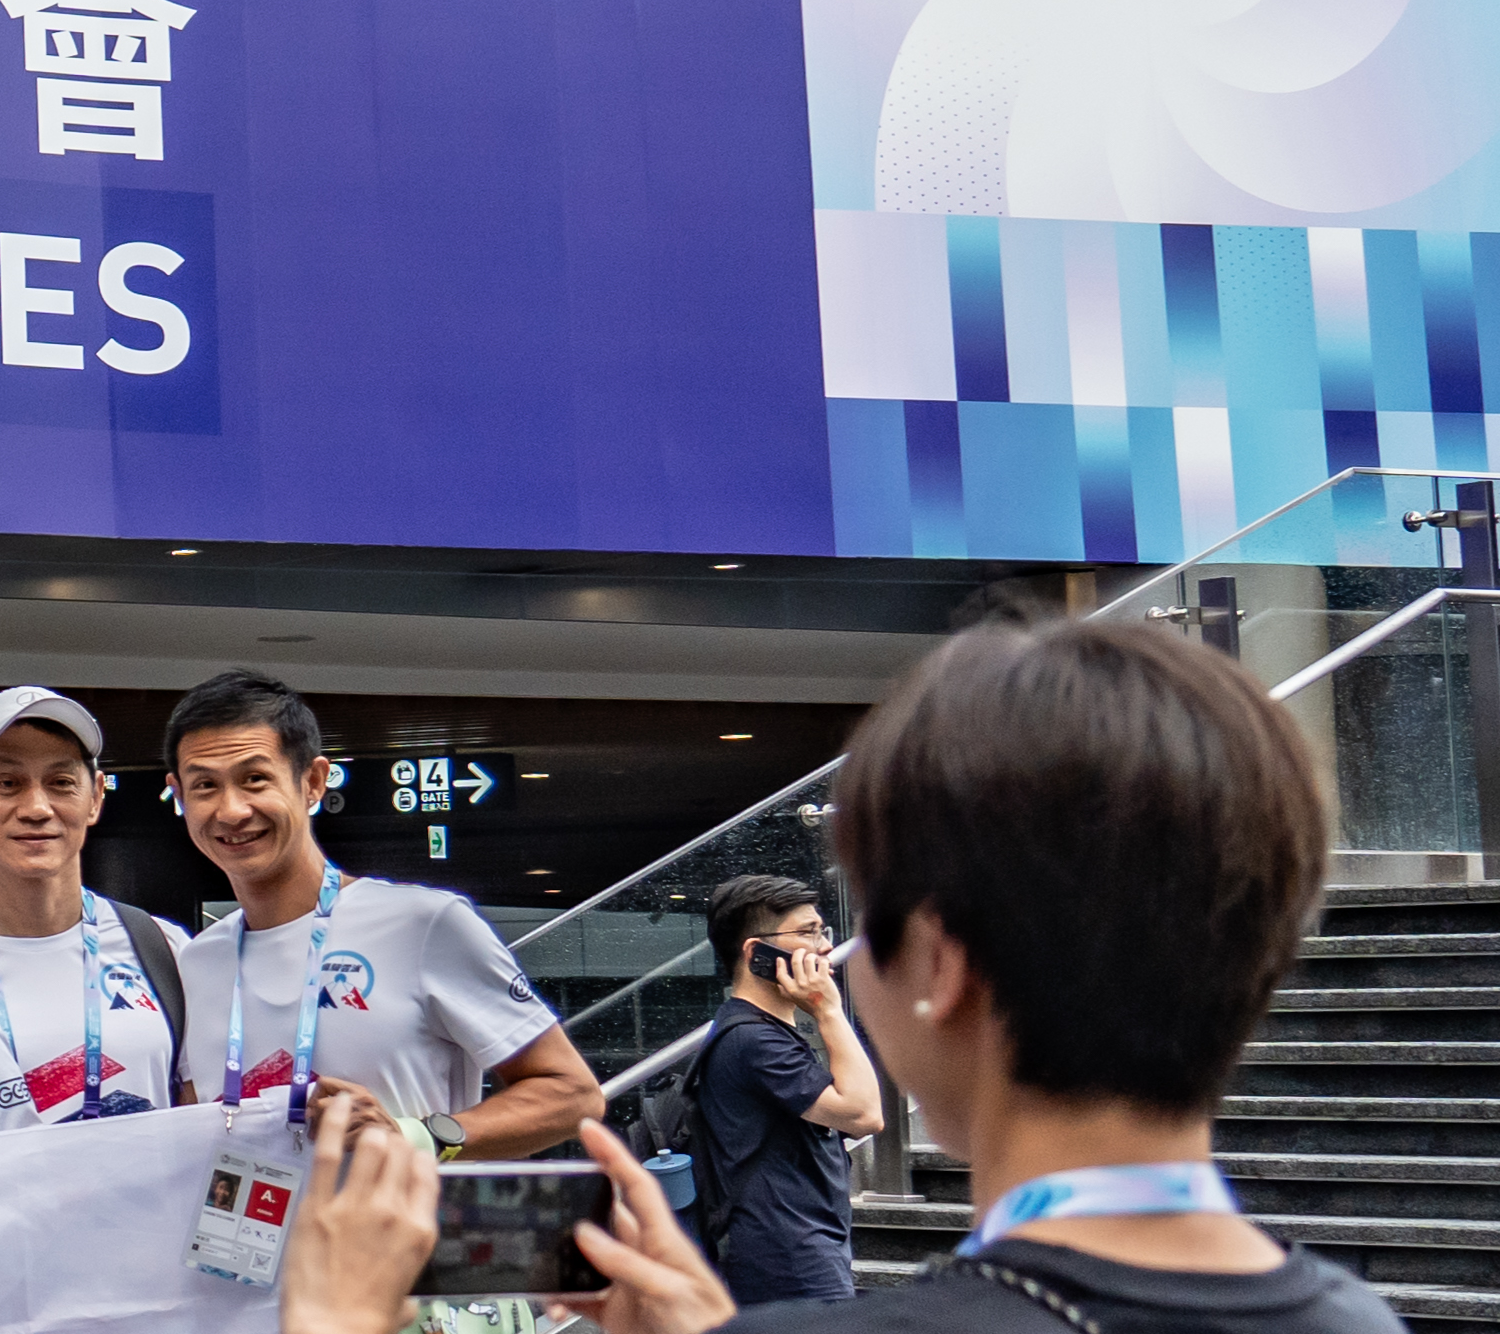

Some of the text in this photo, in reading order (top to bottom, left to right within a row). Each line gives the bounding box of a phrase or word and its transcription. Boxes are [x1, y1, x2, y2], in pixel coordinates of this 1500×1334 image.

[425, 762, 444, 787] 4
[328, 795, 340, 810] P
[420, 791, 450, 803] GATE
